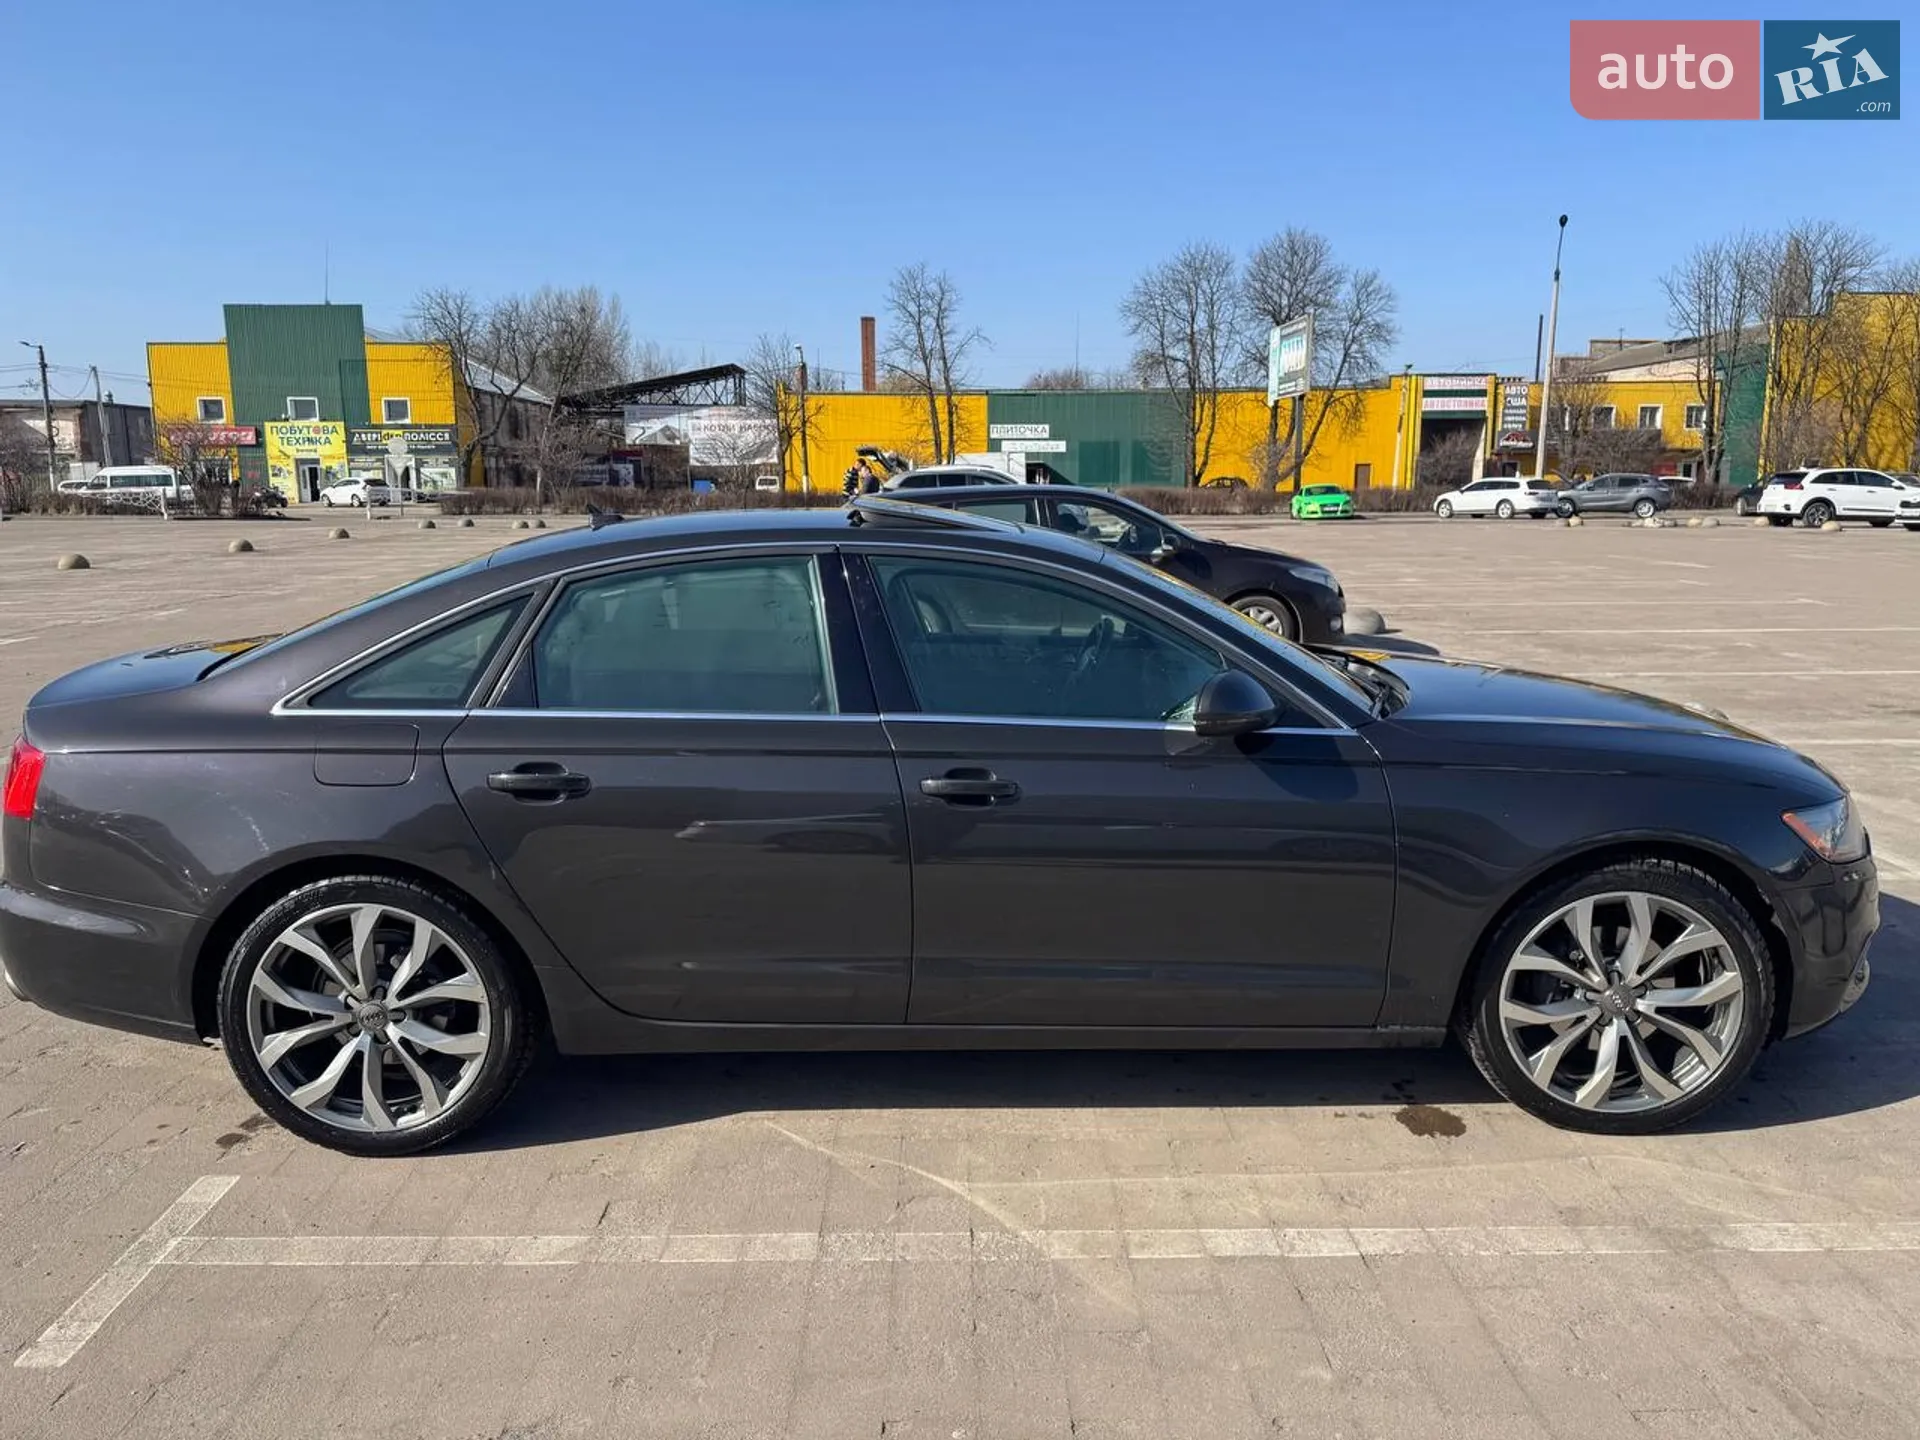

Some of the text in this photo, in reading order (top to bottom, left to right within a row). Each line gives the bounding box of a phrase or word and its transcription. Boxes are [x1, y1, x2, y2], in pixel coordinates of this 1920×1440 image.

[1505, 386, 1528, 395] АВТО
[1506, 397, 1526, 406] США
[269, 425, 339, 435] ПОБУТОВА
[404, 432, 450, 441] ПОЛІССЯ
[278, 436, 333, 447] ТЕХНІКА
